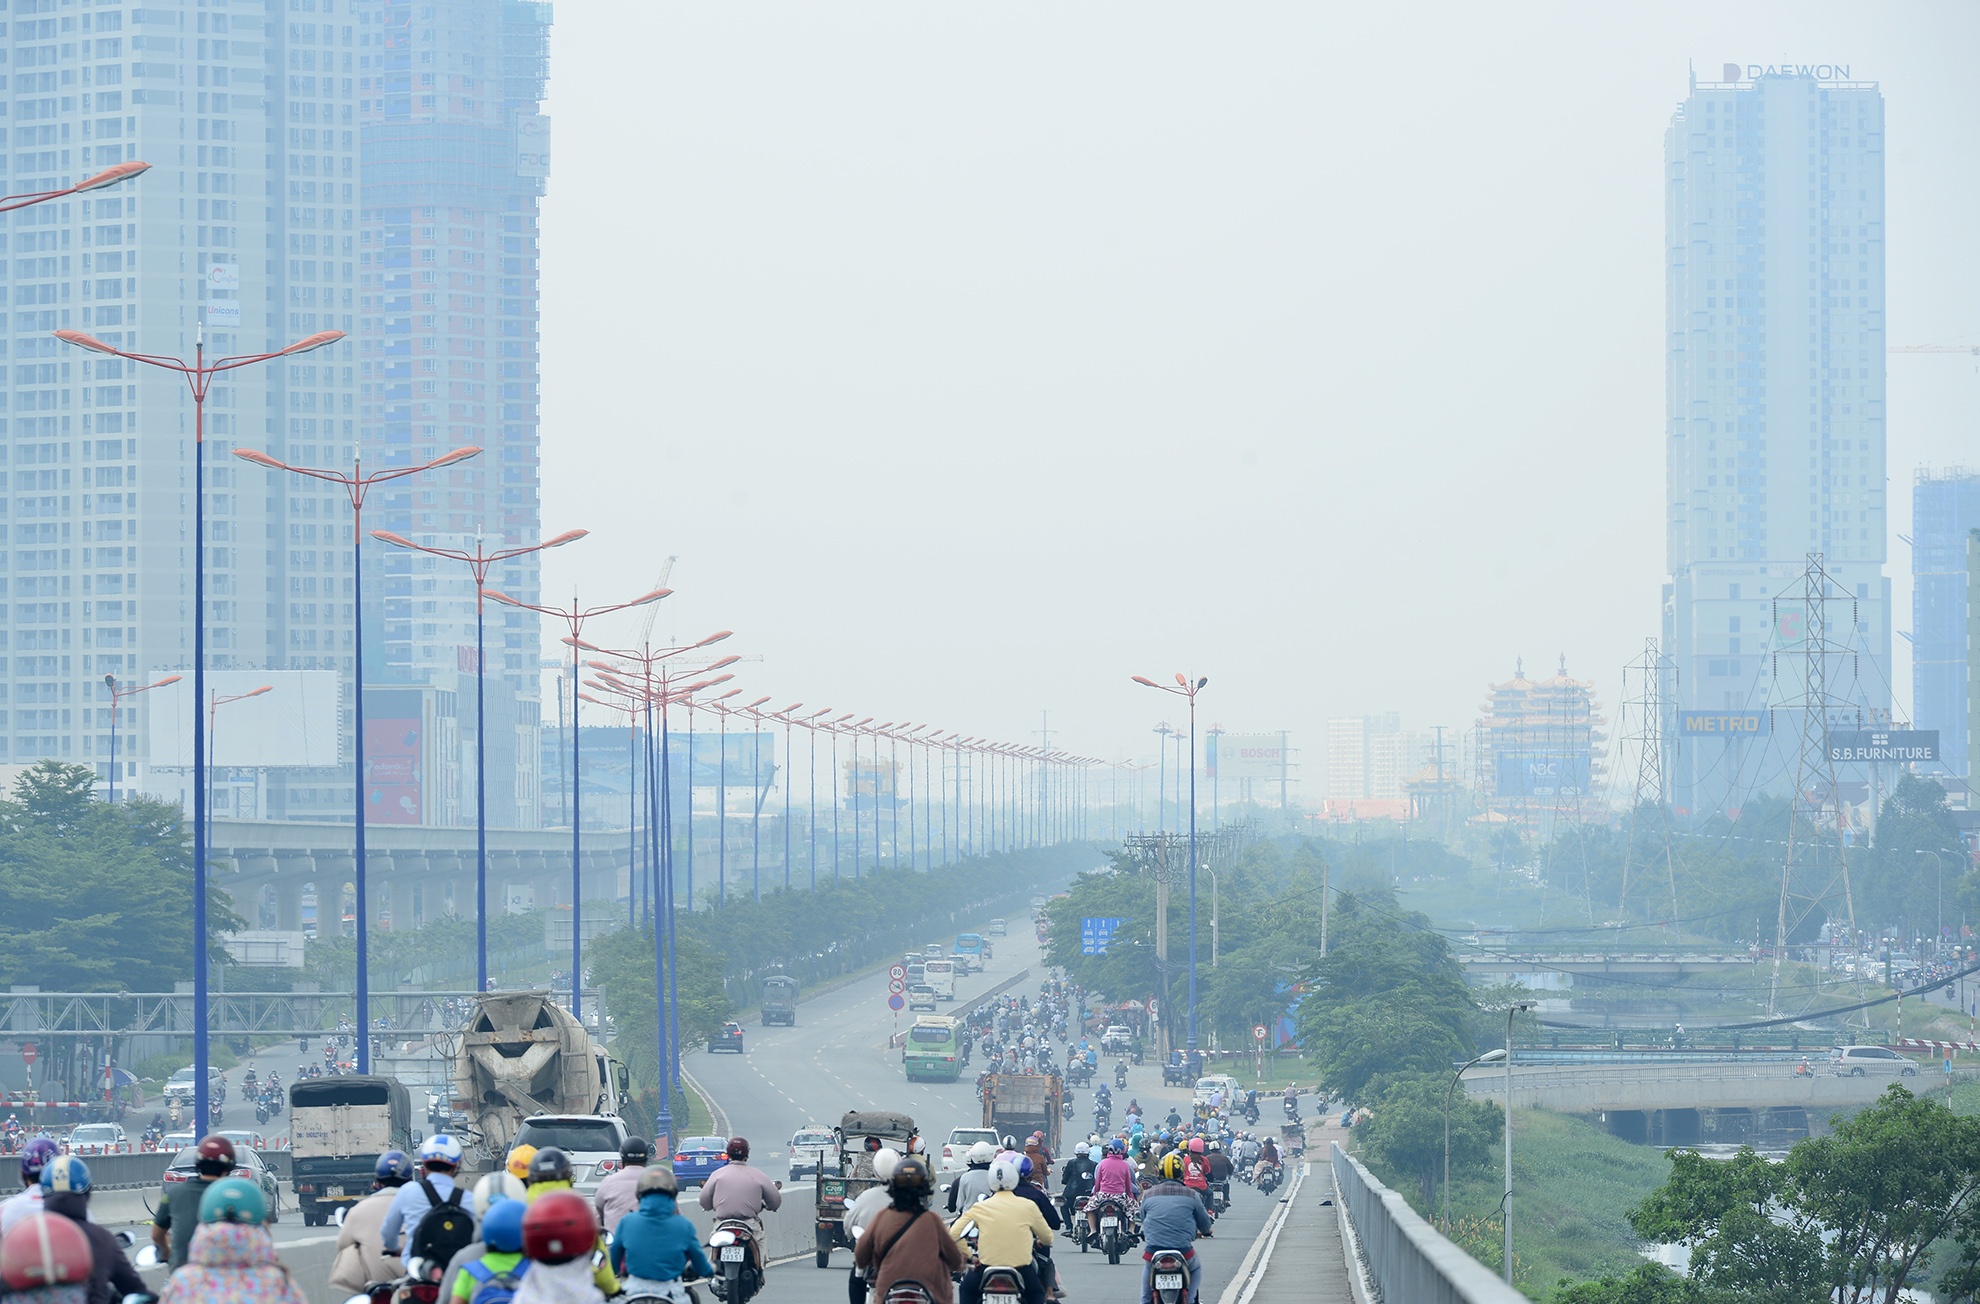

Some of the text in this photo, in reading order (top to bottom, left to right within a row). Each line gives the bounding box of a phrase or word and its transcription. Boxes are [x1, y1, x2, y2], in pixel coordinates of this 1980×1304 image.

[1747, 64, 1850, 80] DAEWON
[519, 153, 549, 166] FDC
[207, 305, 239, 315] Unicons
[1686, 716, 1759, 732] METRO
[1240, 748, 1280, 758] BOSCH
[893, 968, 902, 976] 80
